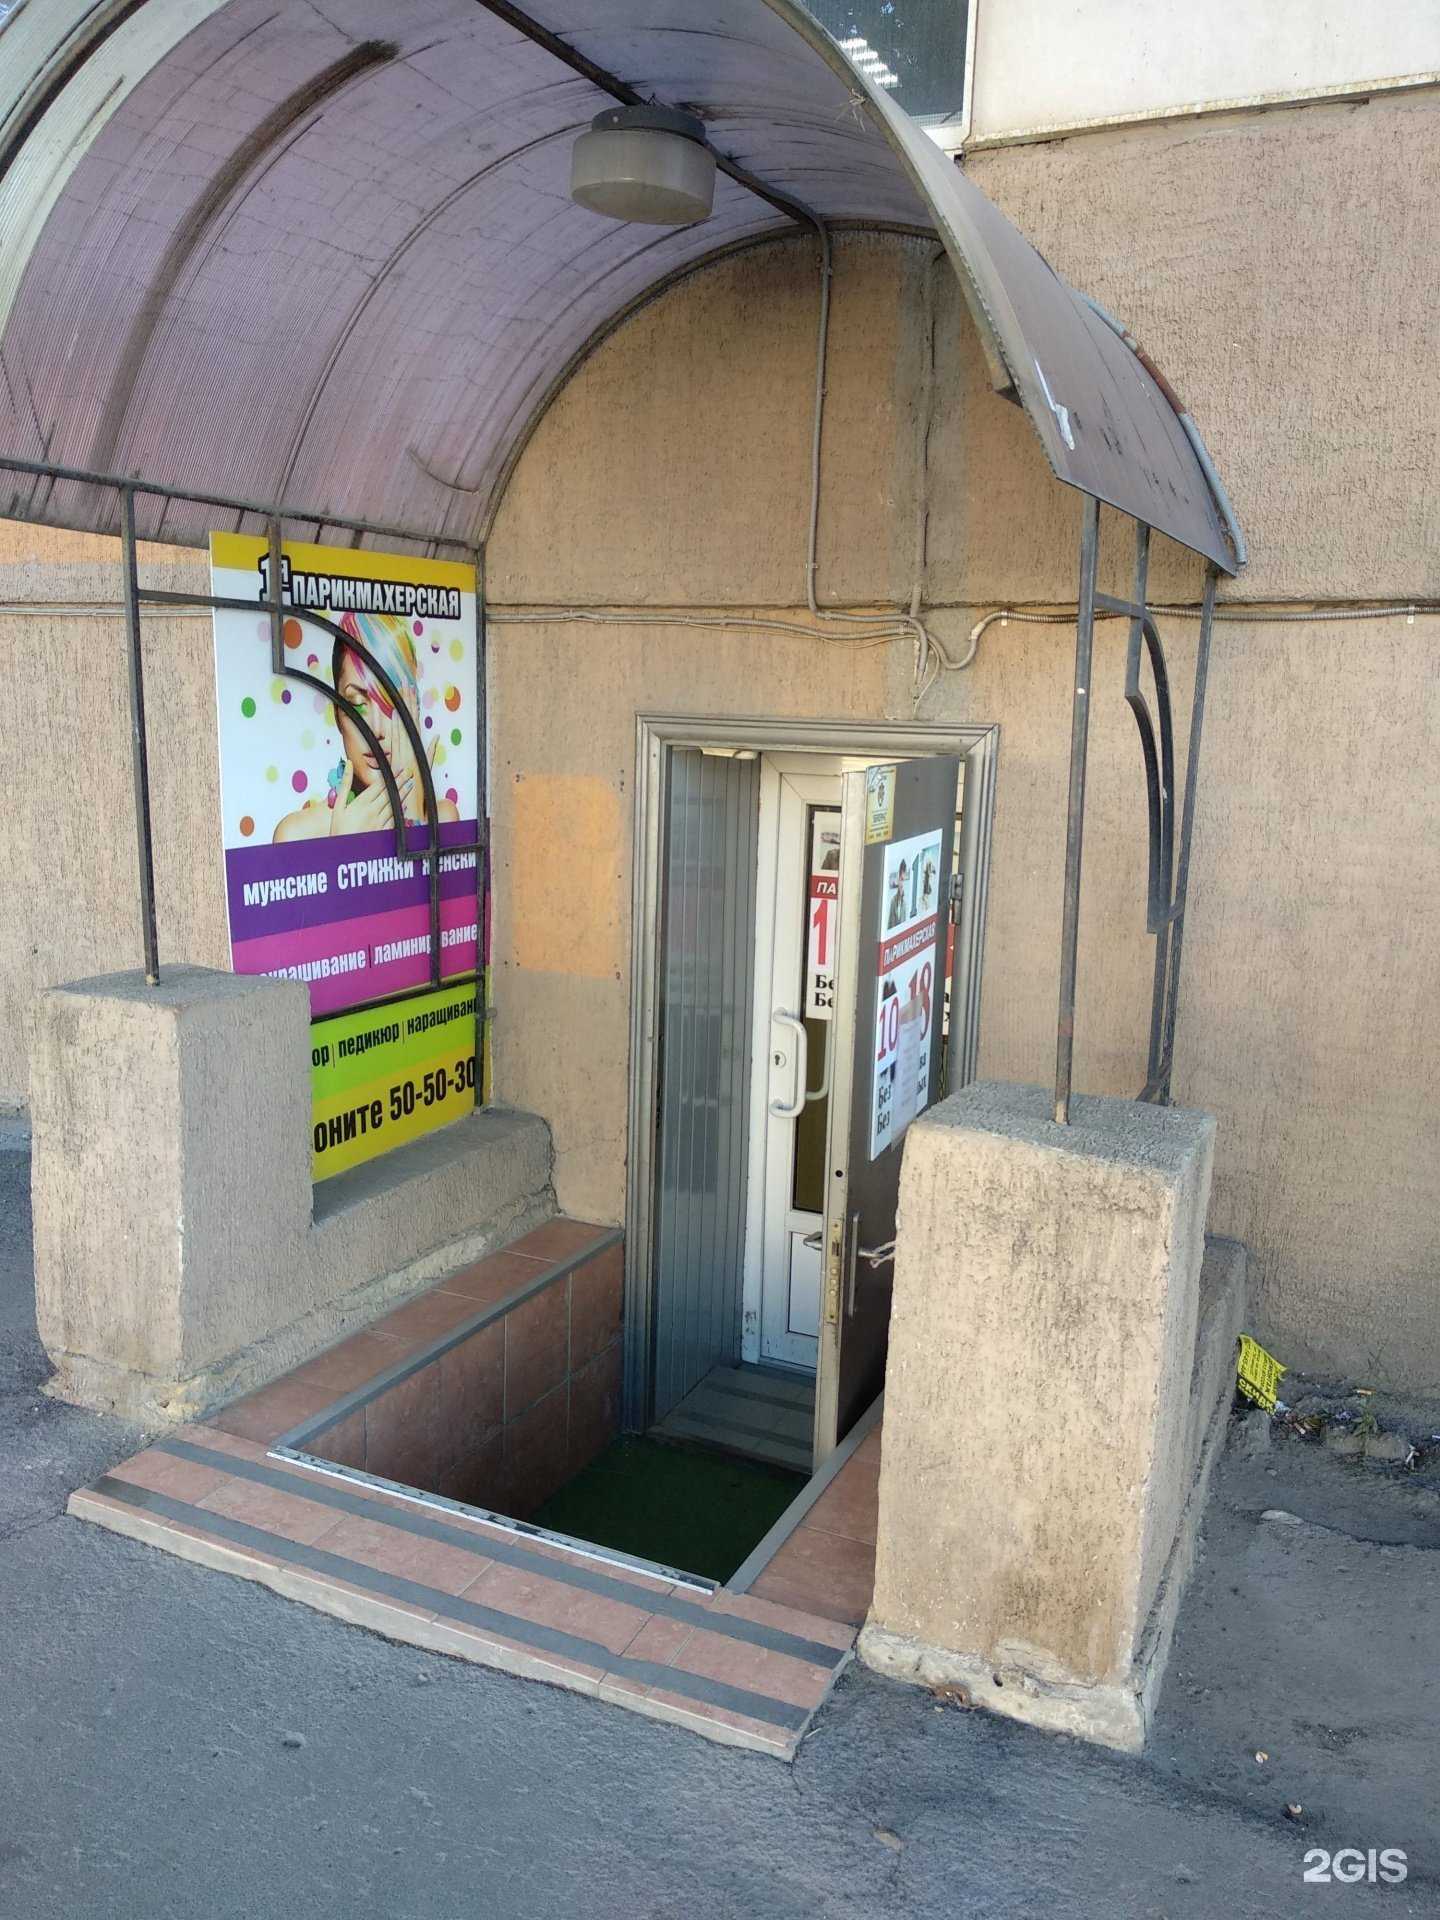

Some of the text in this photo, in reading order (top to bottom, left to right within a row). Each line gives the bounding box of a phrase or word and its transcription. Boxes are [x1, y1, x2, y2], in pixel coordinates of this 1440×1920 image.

[293, 574, 461, 617] ПАРИКМАХЕРСКАЯ
[338, 856, 414, 890] СТРИЖКИ
[374, 923, 477, 966] ламинирвание
[338, 1021, 400, 1059] педикюр
[313, 1055, 477, 1154] оните 50-50-30
